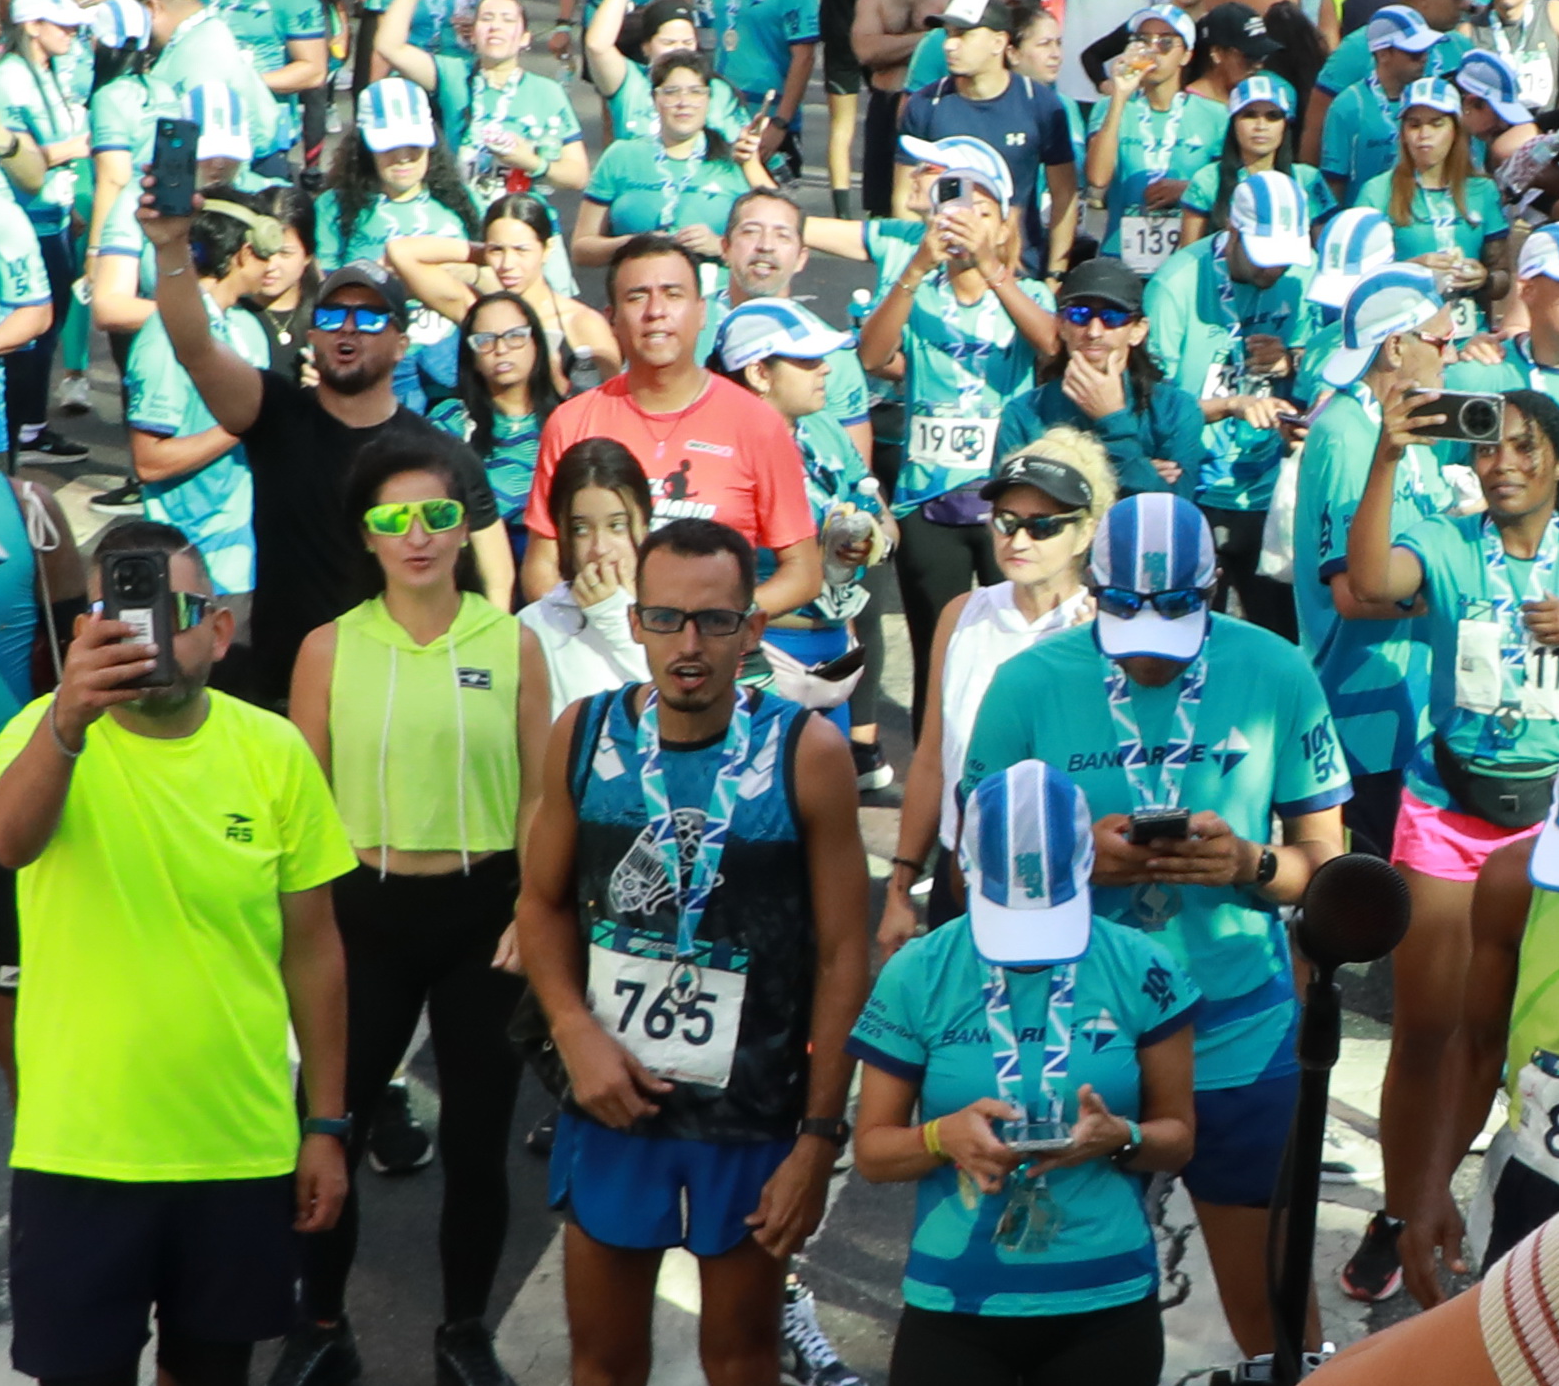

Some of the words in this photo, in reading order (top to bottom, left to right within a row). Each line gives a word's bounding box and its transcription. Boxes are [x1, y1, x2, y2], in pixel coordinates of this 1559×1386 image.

[1136, 228, 1181, 256] 139
[226, 826, 254, 843] RS
[613, 979, 717, 1046] 765
